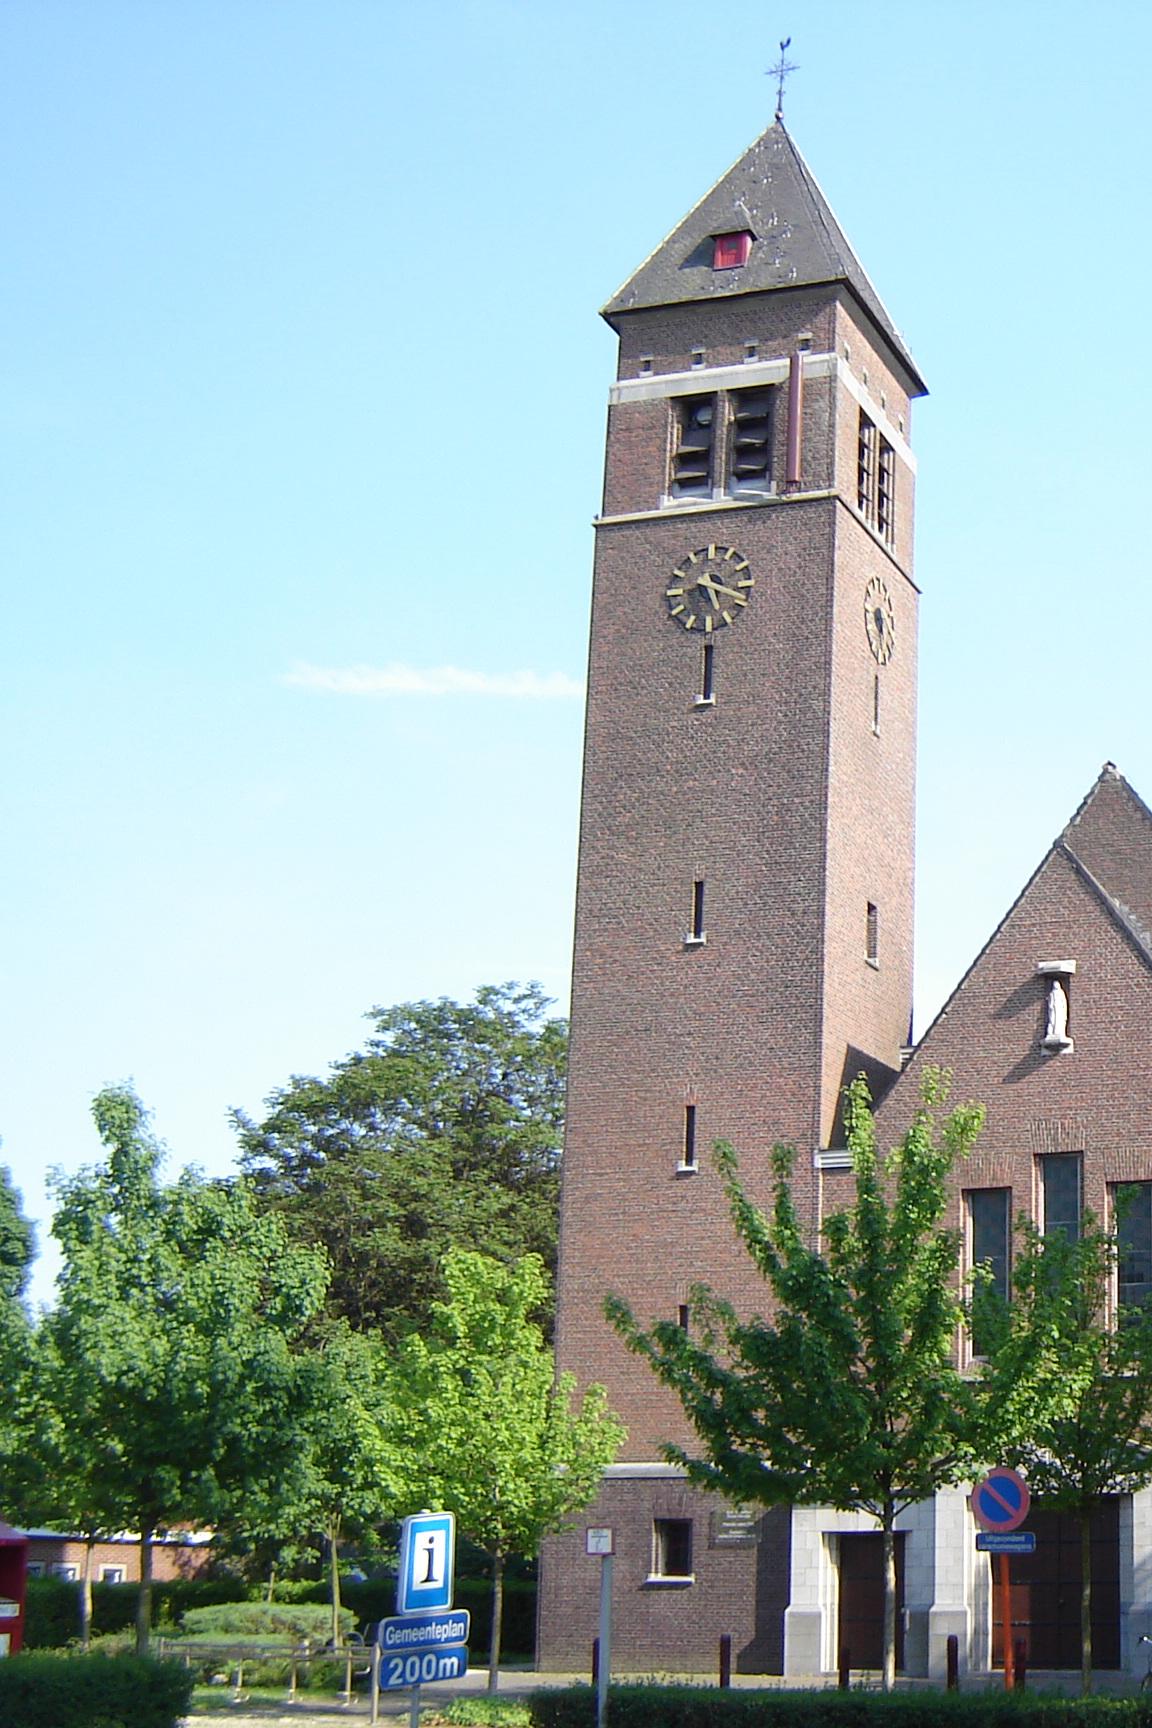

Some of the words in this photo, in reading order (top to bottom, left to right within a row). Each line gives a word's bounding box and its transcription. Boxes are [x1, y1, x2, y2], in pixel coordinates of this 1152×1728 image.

[419, 1536, 439, 1584] i
[386, 1620, 464, 1645] Gemeenteplan
[388, 1653, 459, 1685] 200m
